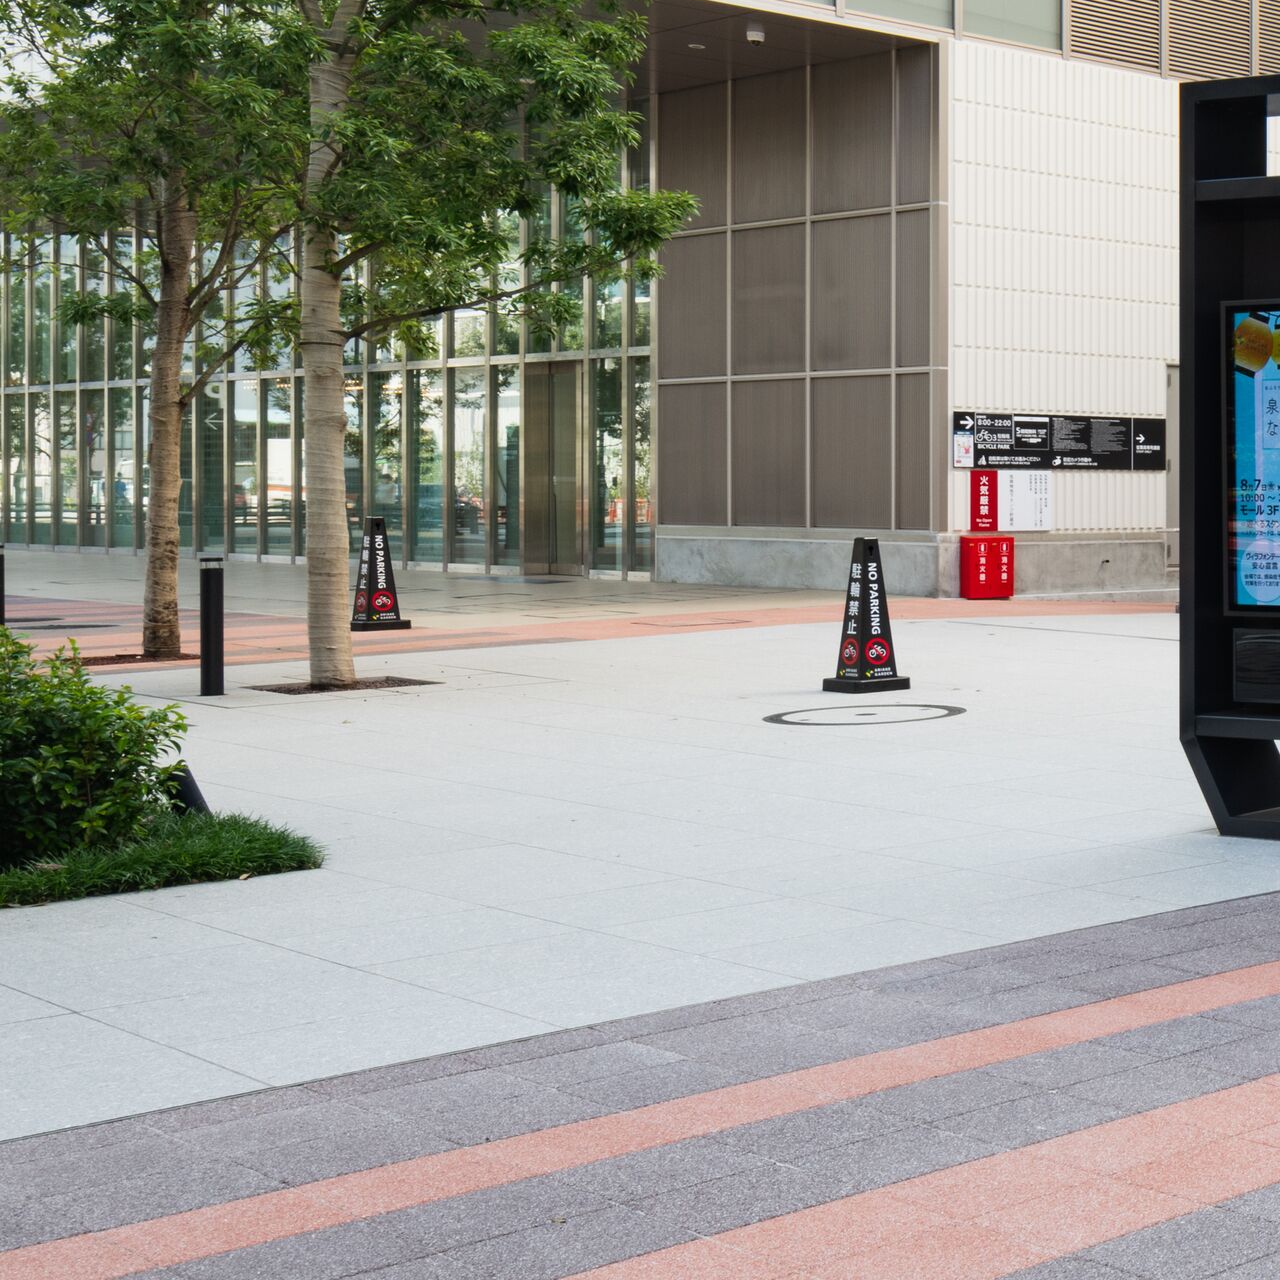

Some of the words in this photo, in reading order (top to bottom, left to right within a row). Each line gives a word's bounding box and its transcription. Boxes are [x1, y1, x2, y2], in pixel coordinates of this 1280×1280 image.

[979, 475, 989, 515] 火気厳禁
[1240, 493, 1265, 502] 10:00
[1240, 505, 1264, 516] モール
[1267, 505, 1279, 516] 3F
[375, 535, 384, 549] NO
[376, 551, 387, 589] PARKING
[868, 562, 878, 581] NO
[847, 563, 862, 635] 駐輪禁止
[869, 583, 881, 635] PARKING
